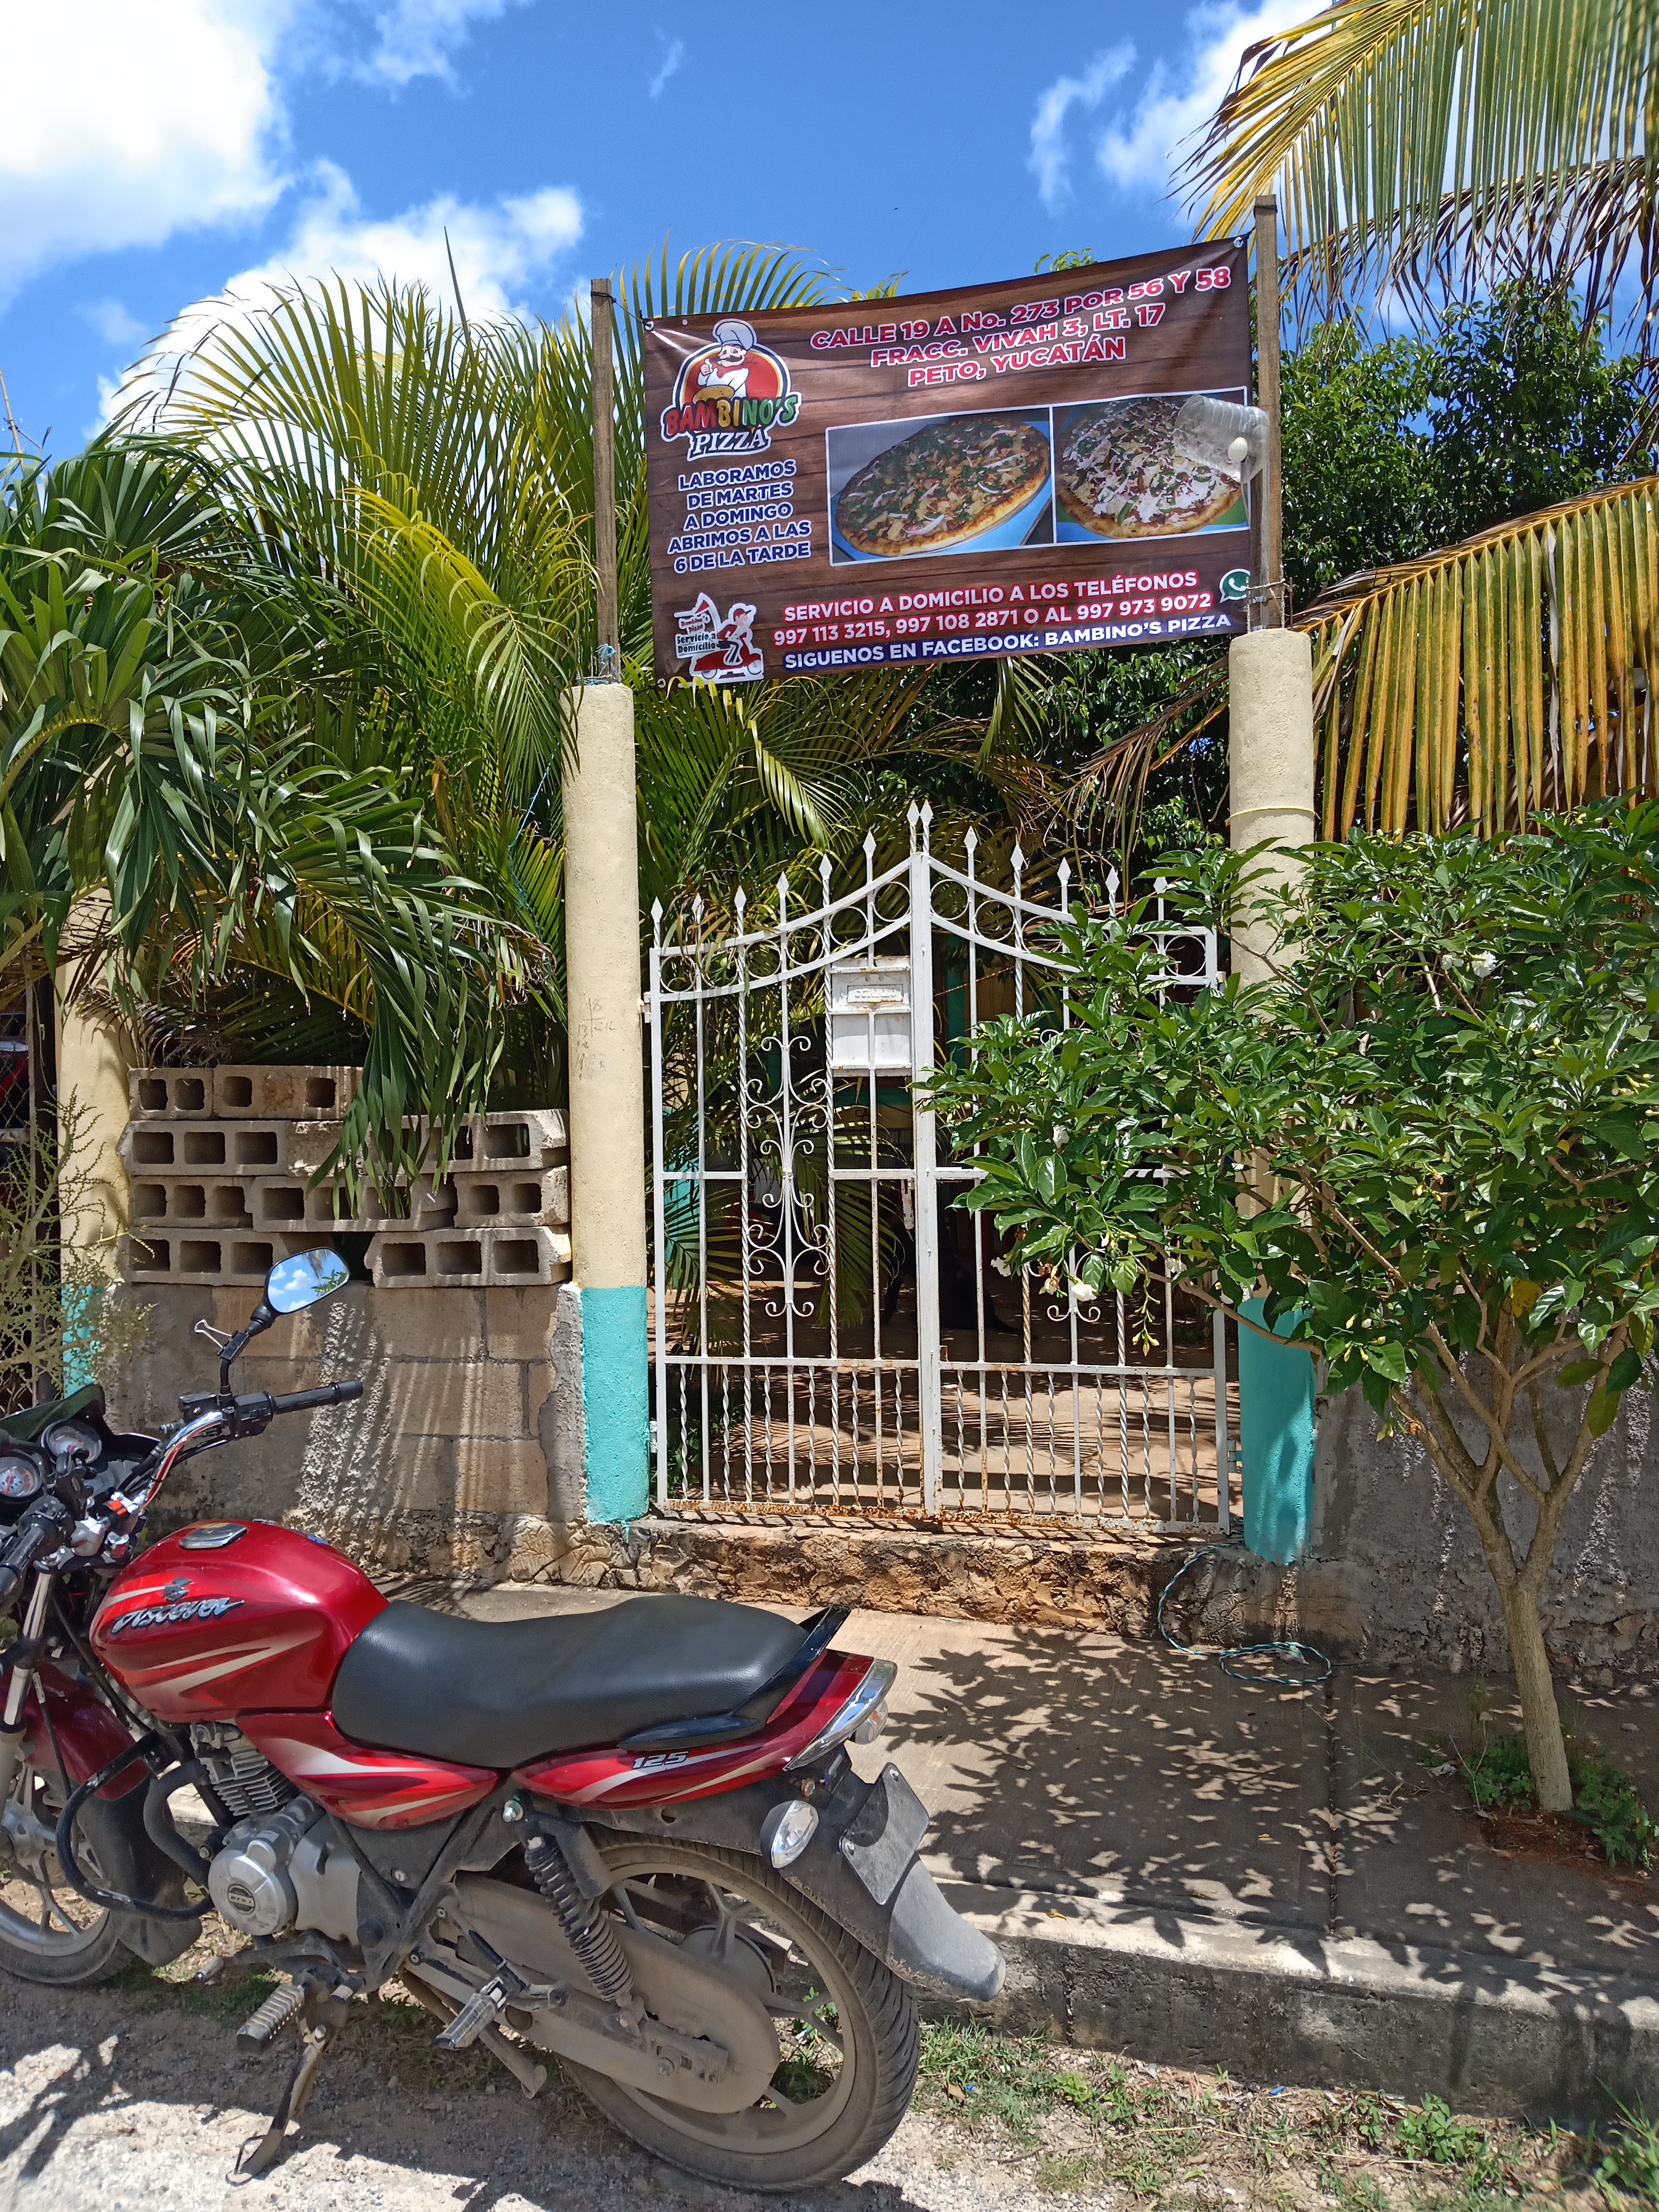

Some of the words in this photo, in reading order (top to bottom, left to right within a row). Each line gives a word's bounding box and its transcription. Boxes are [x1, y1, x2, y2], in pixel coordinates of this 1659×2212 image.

[811, 324, 896, 349] CALLE
[901, 320, 930, 339] 19
[934, 316, 956, 336] A
[962, 312, 1005, 332] No.
[1011, 300, 1059, 324] 273
[1065, 289, 1123, 313] POR
[1128, 279, 1164, 300] 56
[1169, 271, 1190, 293] Y
[1196, 267, 1231, 291] 58
[871, 341, 968, 367] FRACC.
[973, 322, 1058, 353] VIVAH
[1062, 318, 1088, 337] 3,
[1093, 308, 1131, 331] LT.
[1135, 303, 1166, 327] 17
[908, 361, 986, 386] PETO,
[991, 334, 1126, 373] YUCATÁN
[666, 397, 796, 436] BAMBINO'S
[693, 430, 766, 454] PIZZA
[679, 459, 796, 491] LABORAMOS
[688, 492, 713, 509] DE
[716, 481, 793, 504] MARTES
[684, 514, 699, 531] A
[702, 502, 793, 527] DOMINGO
[668, 528, 751, 553] ABRIMOS
[754, 526, 769, 542] A
[773, 520, 811, 539] LAS
[675, 557, 686, 574] 6
[690, 553, 716, 572] DE
[719, 550, 745, 567] LA
[747, 541, 810, 564] TARDE
[784, 599, 873, 621] SERVICIO
[879, 597, 894, 613] A
[899, 587, 1003, 611] DOMICILIO
[1010, 586, 1024, 601] A
[1030, 582, 1068, 600] LOS
[1074, 571, 1197, 597] TELÉFONOS
[774, 628, 807, 646] 997
[812, 625, 839, 642] 113
[844, 621, 890, 639] 3215,
[896, 617, 930, 634] 997
[936, 613, 970, 631] 108
[975, 609, 1018, 628] 2871
[1024, 608, 1039, 624] O
[1045, 606, 1071, 623] AL
[1077, 603, 1113, 621] 997
[1119, 598, 1155, 616] 973
[1161, 593, 1211, 613] 9072
[677, 633, 709, 644] Servicio
[678, 642, 715, 653] Domicilio
[785, 645, 884, 669] SIGUENOS
[890, 643, 916, 659] EN
[923, 634, 1039, 656] FACEBOOK:
[1045, 621, 1162, 647] BAMBINO'S
[1167, 614, 1231, 633] PIZZA
[854, 988, 897, 998] CORREO
[633, 1751, 690, 1770] 125
